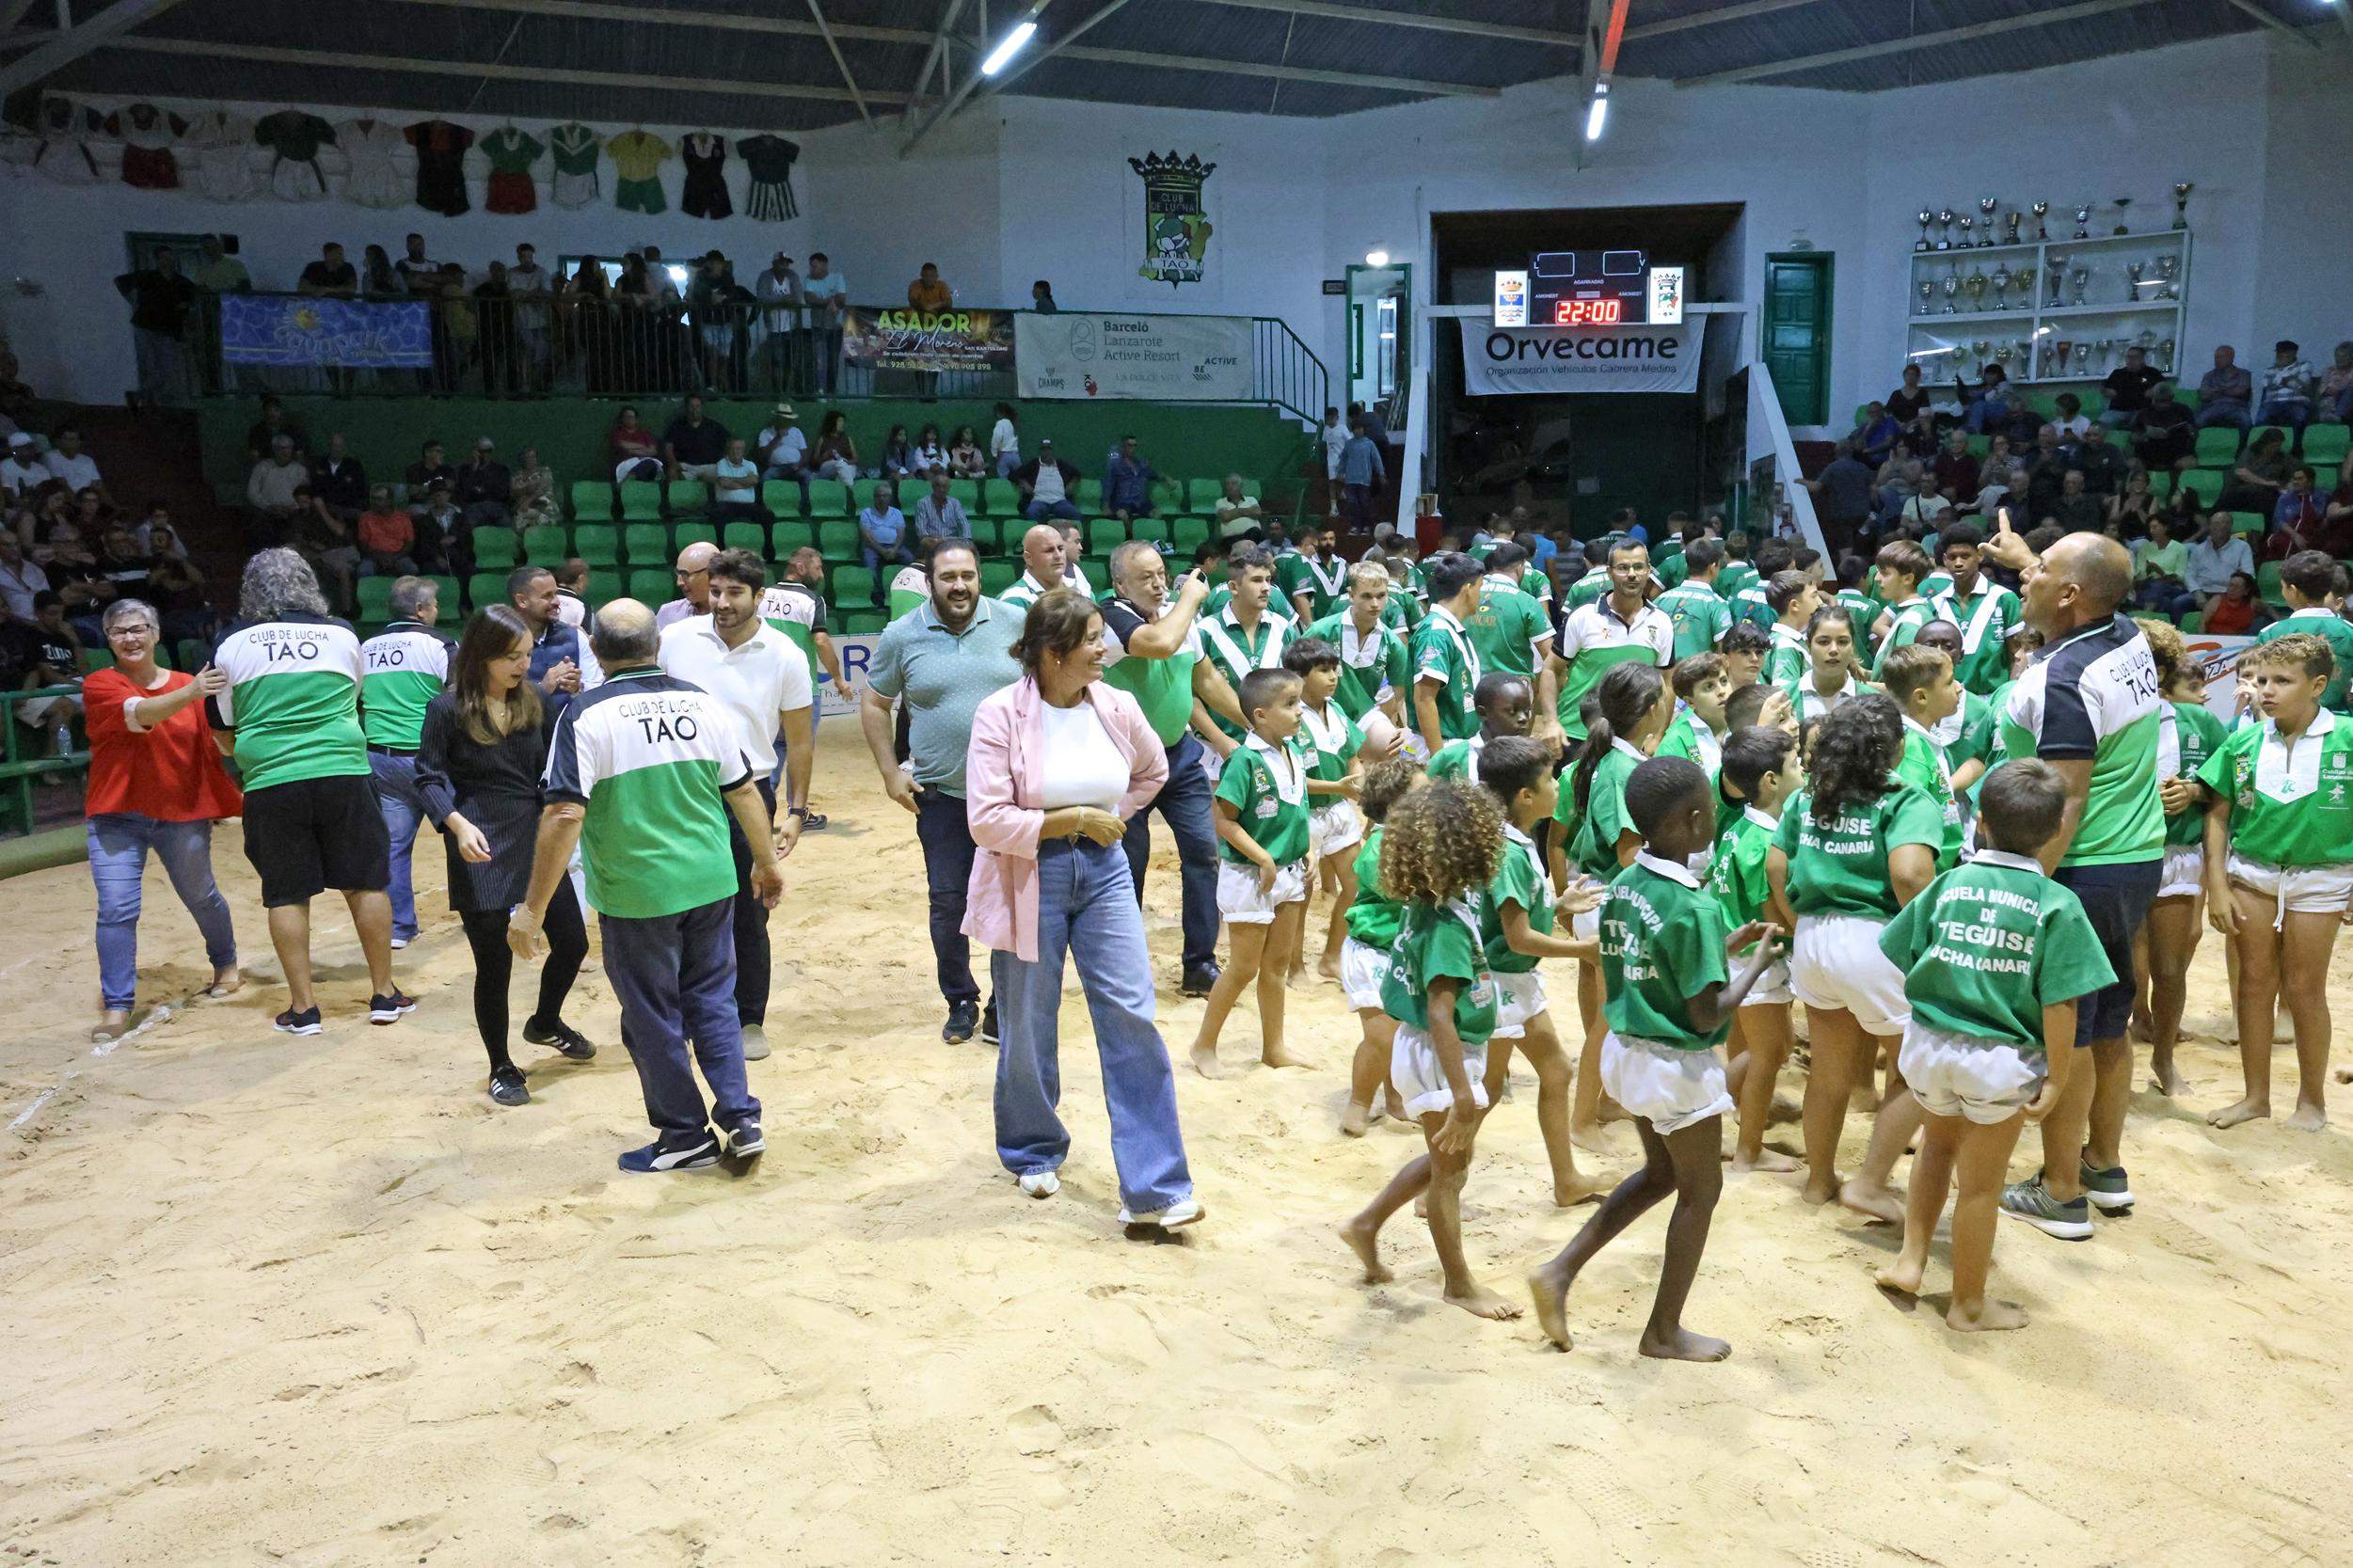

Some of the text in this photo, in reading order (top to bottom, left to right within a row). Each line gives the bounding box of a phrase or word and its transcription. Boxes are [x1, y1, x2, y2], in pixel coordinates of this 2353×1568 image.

[1160, 193, 1184, 202] CLUB
[1162, 260, 1188, 269] TAO
[1534, 261, 1540, 270] L
[1639, 259, 1646, 267] V
[1557, 301, 1619, 323] 22:00
[877, 309, 972, 334] ASADOR
[1104, 321, 1149, 333] Barceló
[1104, 337, 1163, 348] Lanzarote
[1486, 332, 1679, 361] Orvecame
[1104, 350, 1181, 362] Active Resort
[1205, 357, 1239, 366] ACTIVE
[1487, 366, 1549, 377] Organización
[1599, 363, 1638, 373] Cabrera
[1641, 363, 1677, 373] Medina
[767, 600, 792, 616] TAO
[249, 629, 330, 644] CLUB DE LUCHA
[263, 641, 319, 662] TAO
[368, 649, 405, 668] TAO
[2125, 668, 2156, 705] TAO
[618, 701, 650, 718] CLUB
[638, 715, 697, 745] TAO
[1824, 839, 1875, 855] CANARIA
[1980, 907, 1997, 925] DE
